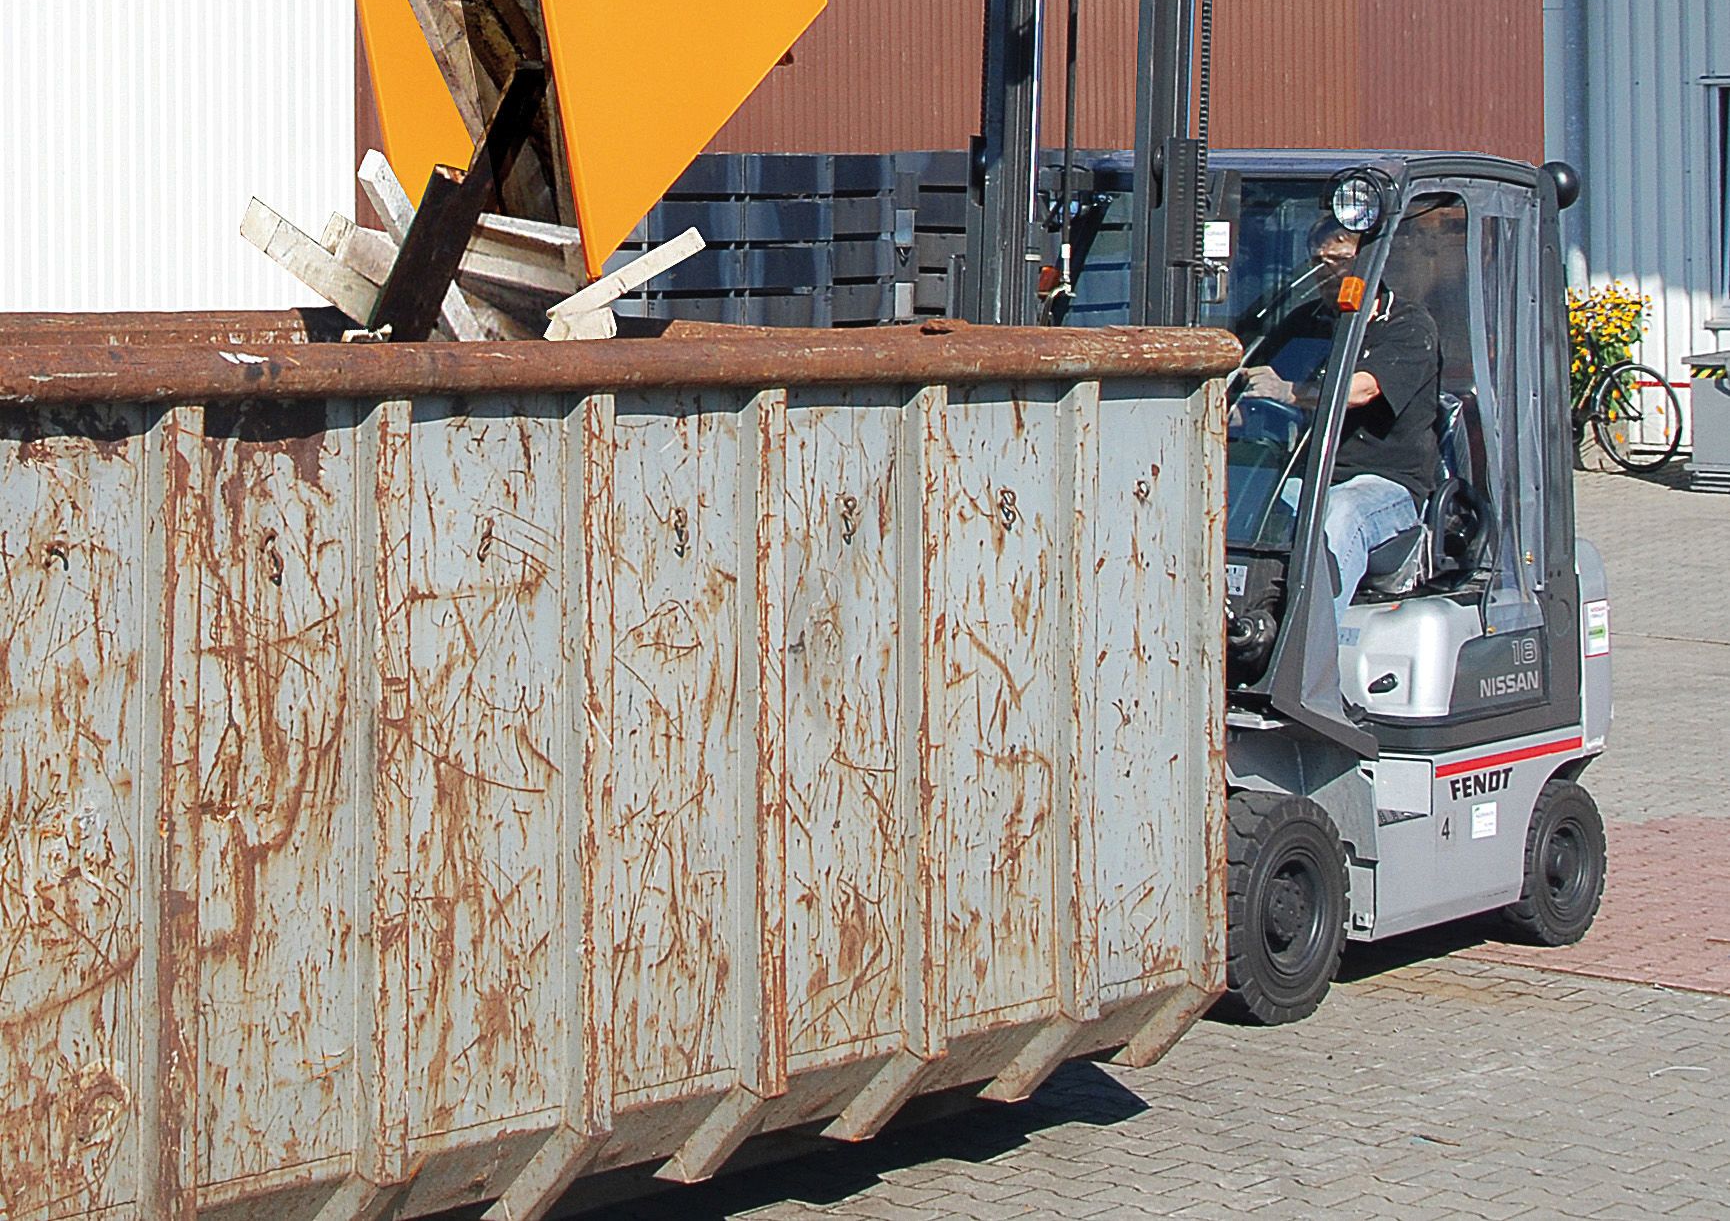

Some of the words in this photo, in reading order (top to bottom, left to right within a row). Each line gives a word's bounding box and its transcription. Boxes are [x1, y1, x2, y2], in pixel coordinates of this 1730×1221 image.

[1511, 637, 1538, 666] 18
[1480, 670, 1539, 698] NISSAN
[1449, 766, 1514, 801] FENDT
[1441, 816, 1451, 840] 4
